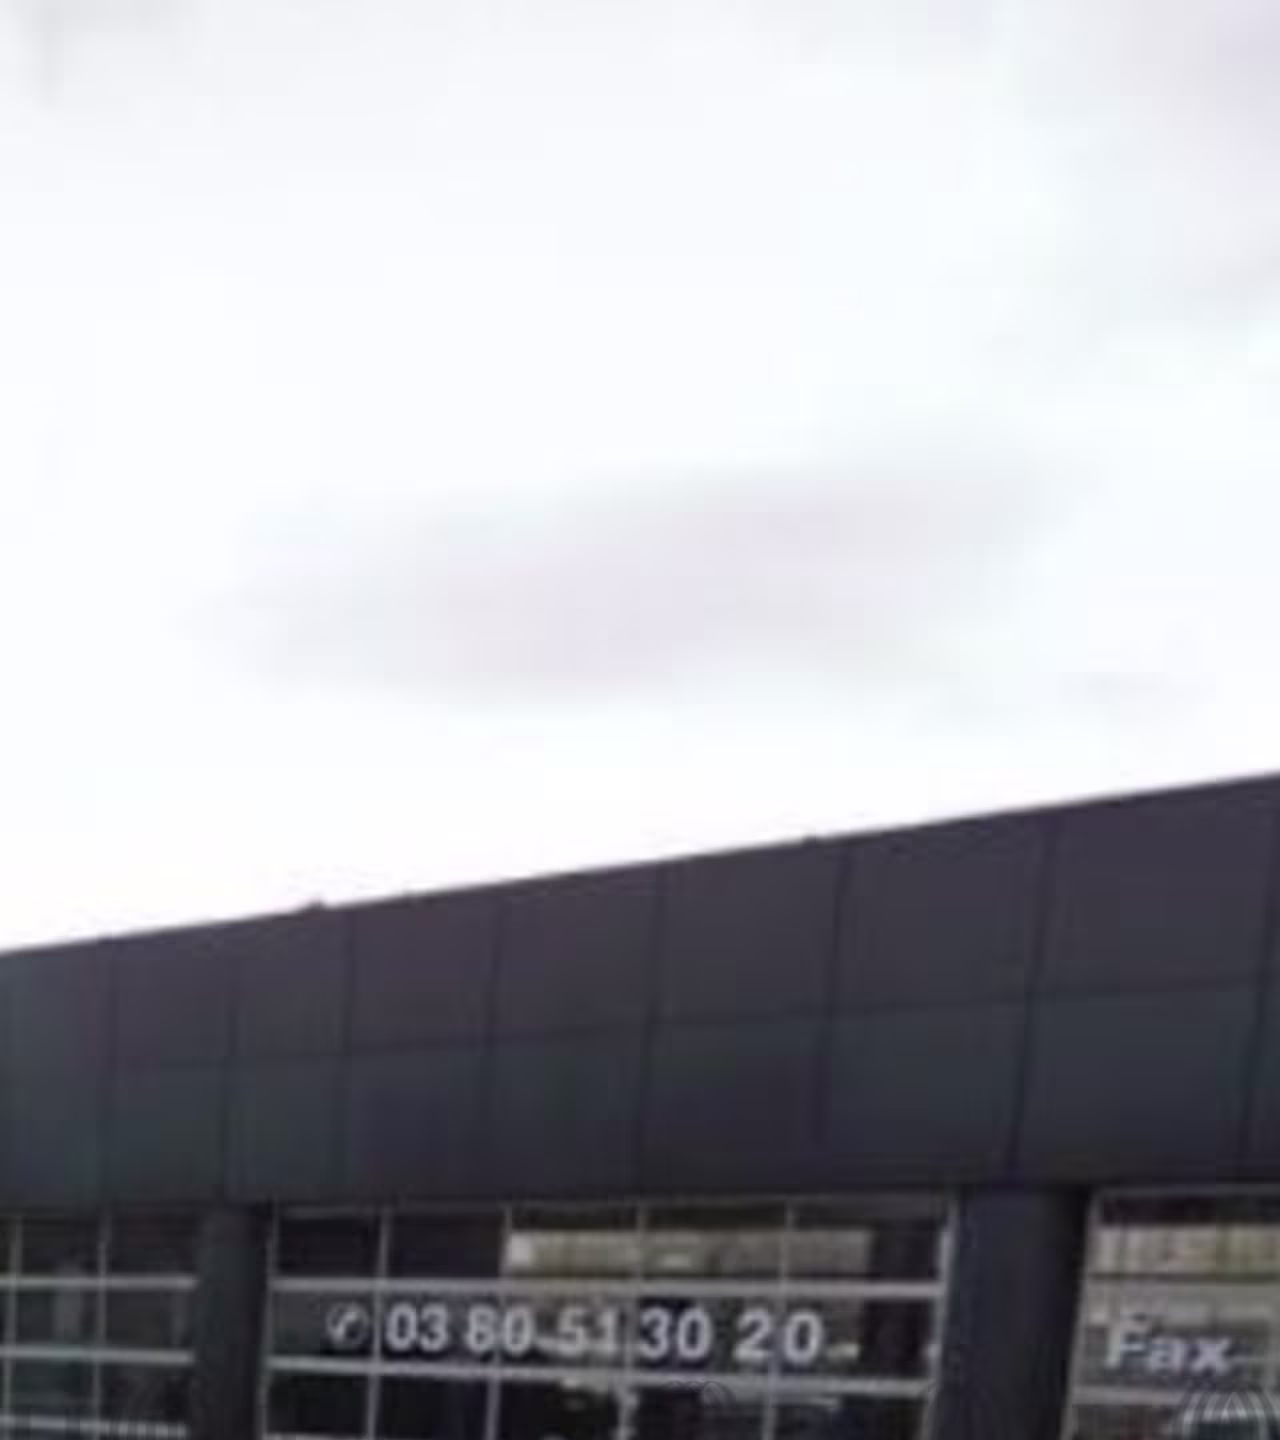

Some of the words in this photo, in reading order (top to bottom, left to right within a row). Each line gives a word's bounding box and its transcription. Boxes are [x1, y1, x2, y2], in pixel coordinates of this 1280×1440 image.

[386, 1304, 449, 1352] 03
[464, 1304, 532, 1356] 80
[556, 1308, 620, 1356] 51
[638, 1307, 710, 1362] 30
[736, 1308, 822, 1366] 20
[1106, 1318, 1232, 1376] Fax
